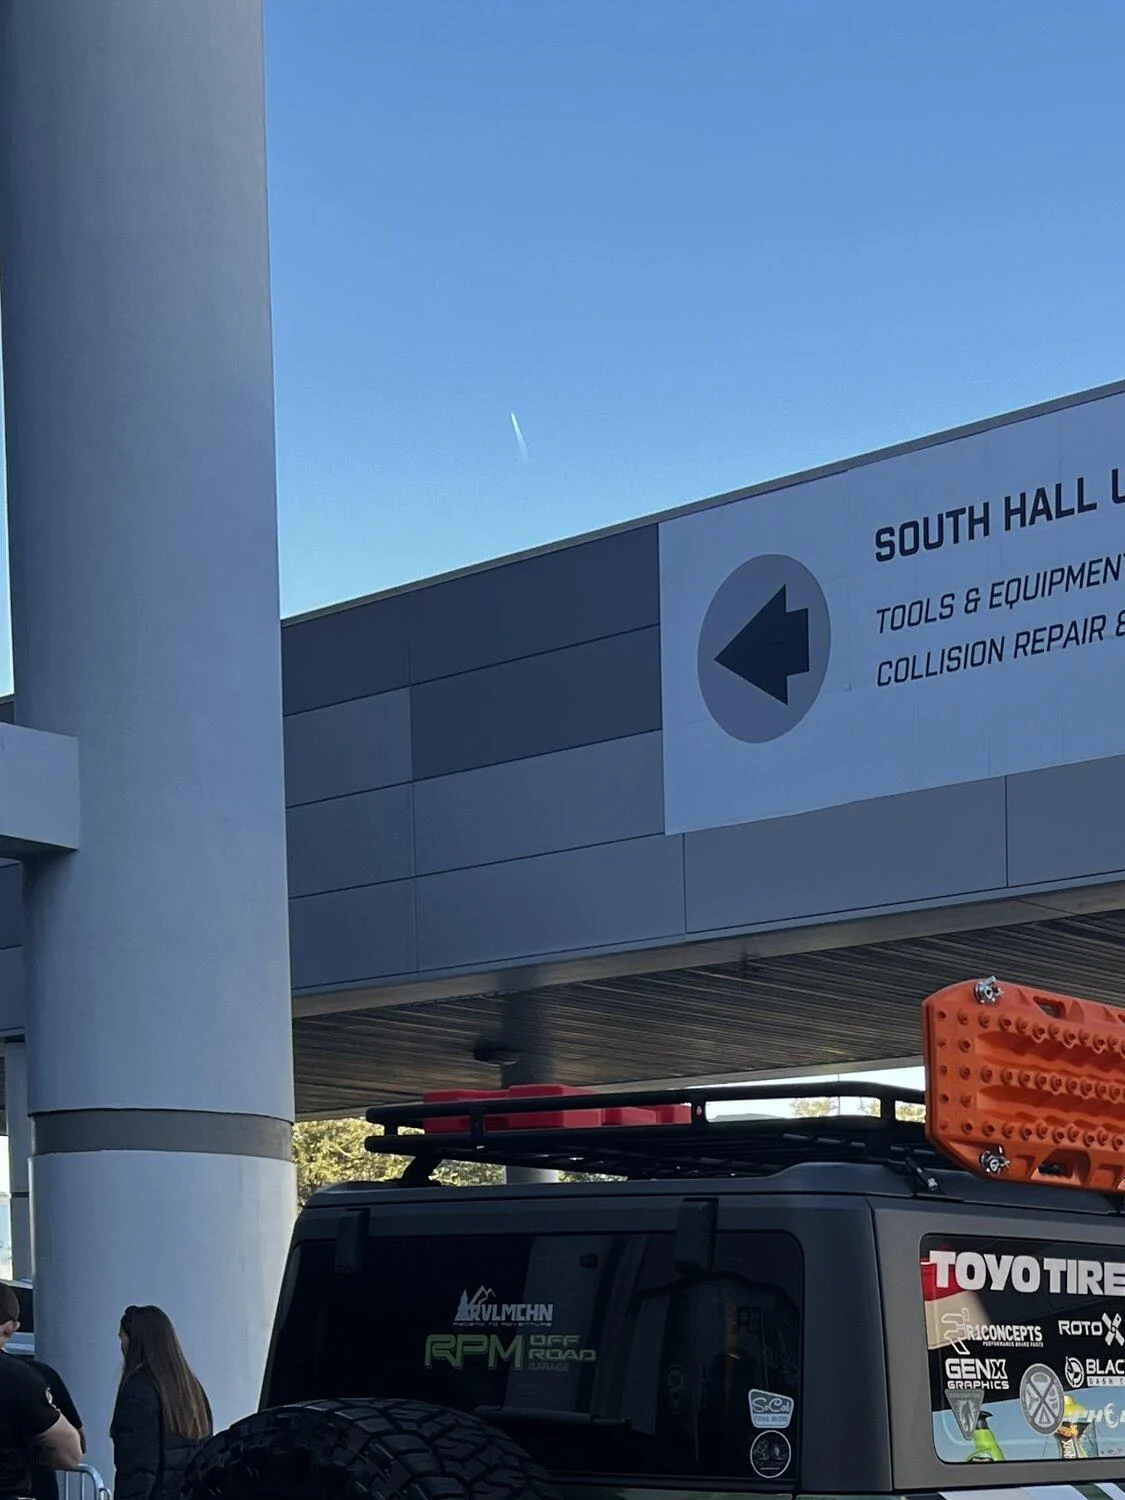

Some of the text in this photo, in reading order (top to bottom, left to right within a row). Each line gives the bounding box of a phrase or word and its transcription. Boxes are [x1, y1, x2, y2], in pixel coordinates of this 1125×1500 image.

[875, 501, 990, 563] SOUTH
[1004, 477, 1097, 531] HALL
[876, 591, 955, 635] TOOLS
[965, 587, 981, 613] &
[877, 638, 1005, 687] COLLISION
[1013, 614, 1105, 660] REPAIR
[929, 1250, 1041, 1294] TOYO
[425, 1333, 524, 1371] RPM
[528, 1348, 597, 1362] ROAD
[530, 1334, 581, 1347] OFF
[528, 1361, 571, 1372] GARAGE
[944, 1358, 1008, 1380] GENX
[947, 1380, 1010, 1390] GRAPHICS
